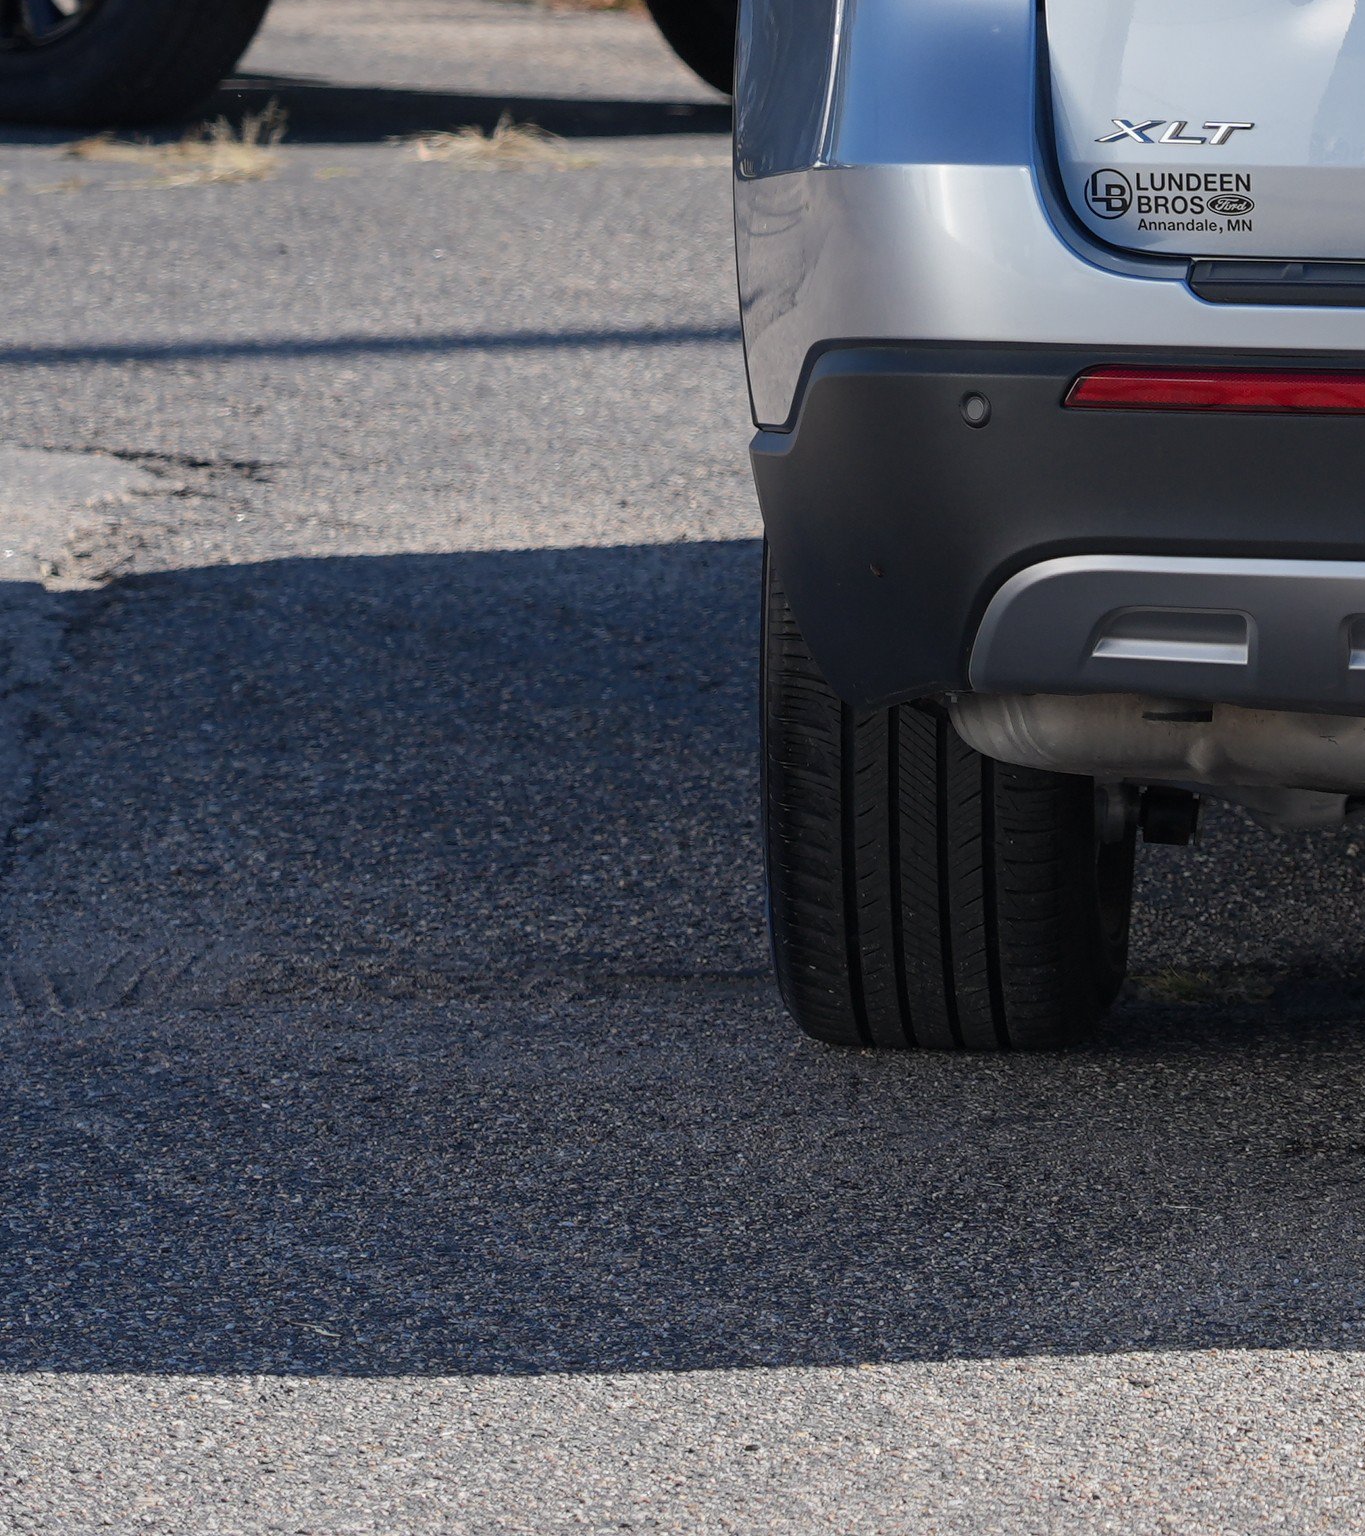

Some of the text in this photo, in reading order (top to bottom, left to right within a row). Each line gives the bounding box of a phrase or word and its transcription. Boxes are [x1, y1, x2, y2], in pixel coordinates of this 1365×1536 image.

[1095, 119, 1255, 145] XLT
[1136, 172, 1251, 191] LUNDEEN
[1137, 195, 1248, 214] BROS Ford
[1138, 218, 1252, 233] Annandale, MN
